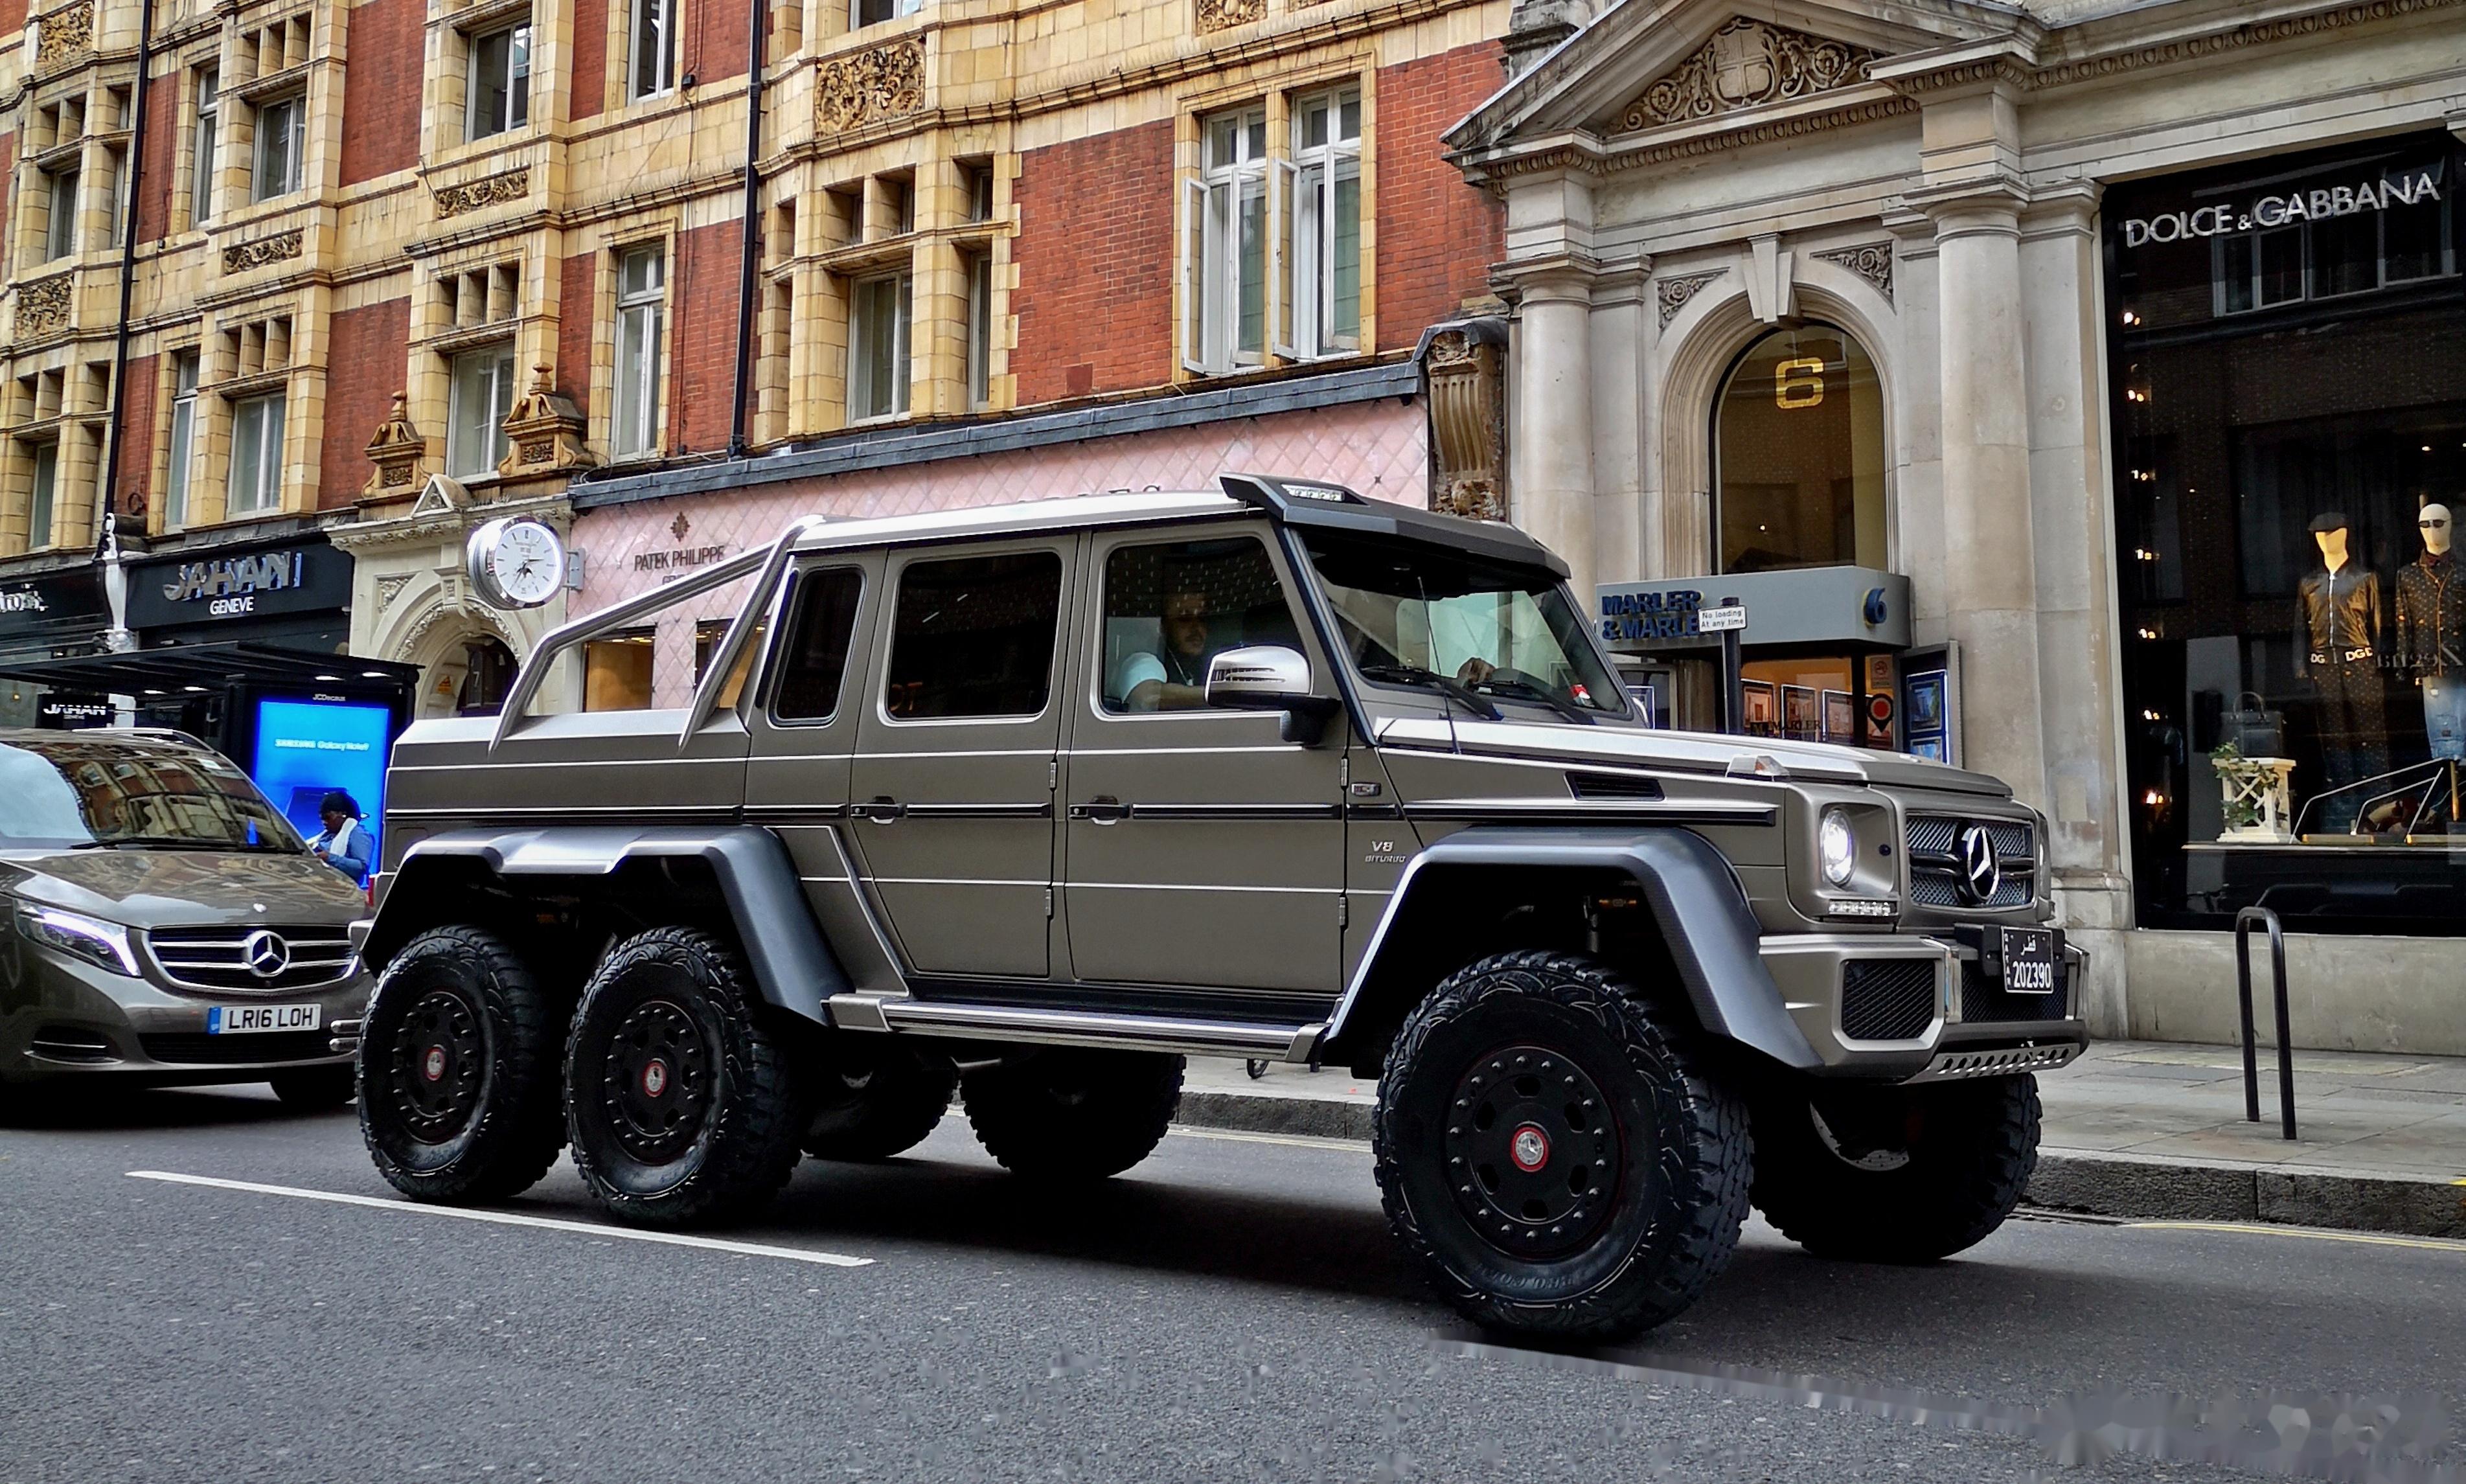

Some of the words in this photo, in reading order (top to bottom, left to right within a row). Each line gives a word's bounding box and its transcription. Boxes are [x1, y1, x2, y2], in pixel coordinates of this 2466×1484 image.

[2125, 204, 2232, 248] DOLCE
[2255, 172, 2441, 227] GABBANA
[1775, 357, 1824, 409] 6
[634, 552, 669, 571] PATEK
[672, 545, 724, 567] PHILIPPE
[210, 597, 254, 615] GENEVE
[1602, 590, 1702, 615] MARLER
[1862, 588, 1888, 624] 6
[1622, 615, 1701, 639] MARLE
[1371, 841, 1393, 852] V8
[2020, 934, 2037, 956] قطر
[2013, 961, 2051, 988] 202390
[229, 1009, 272, 1029] LR16
[278, 1007, 313, 1027] LOH
